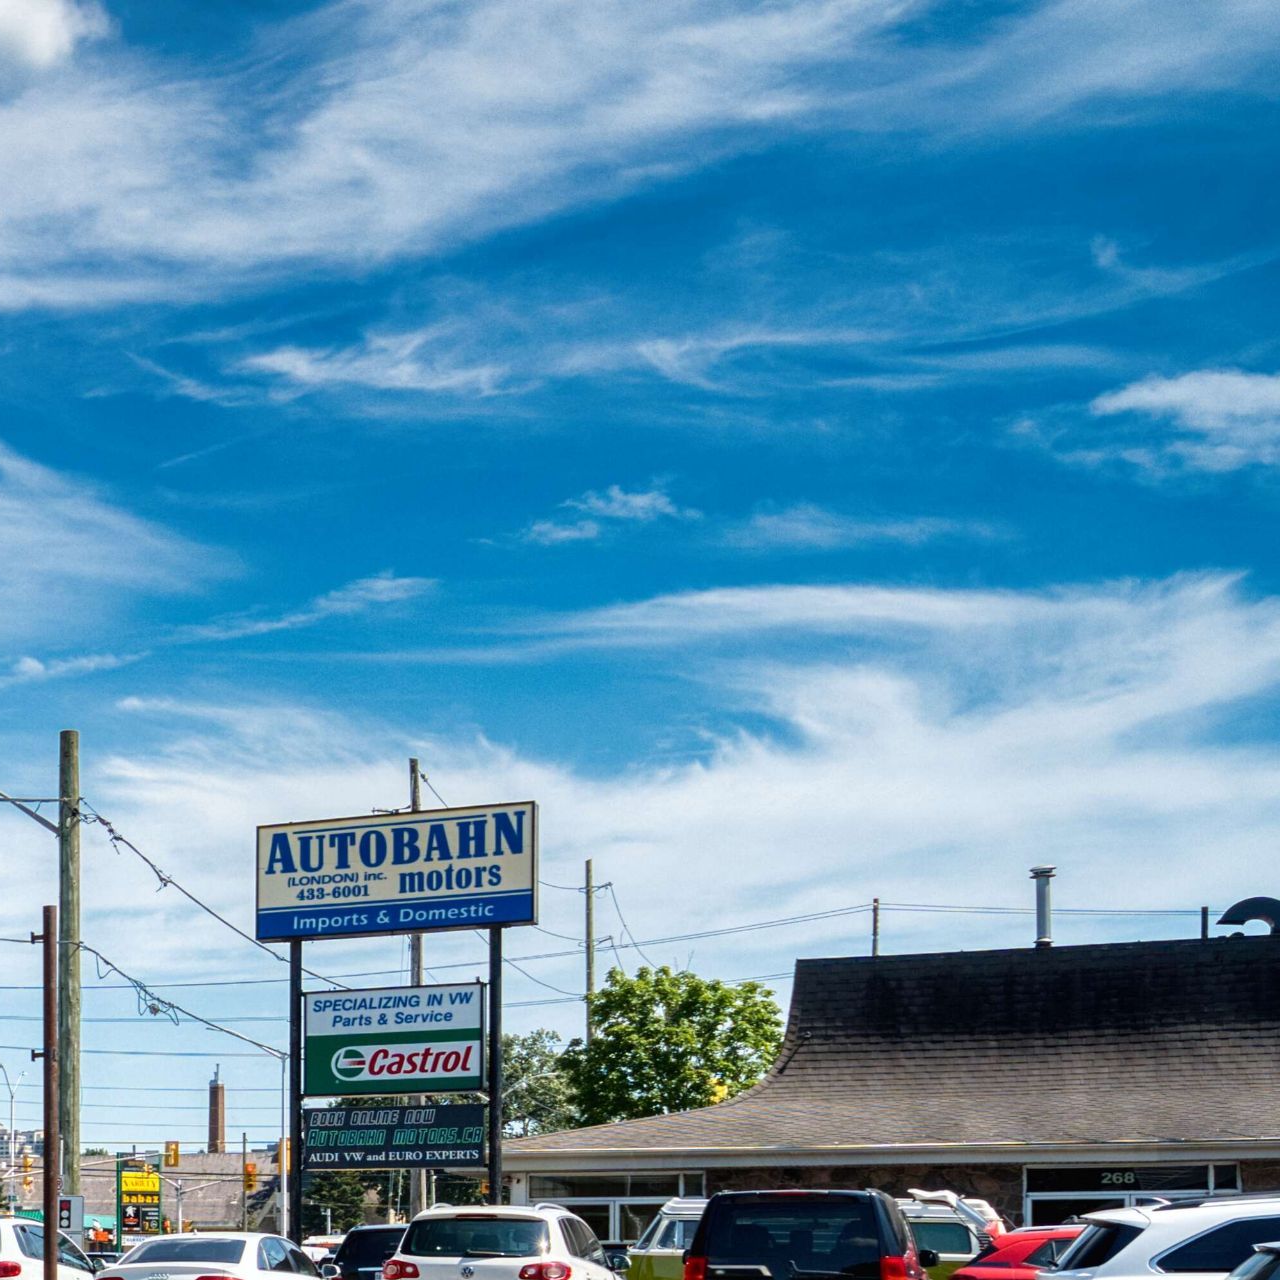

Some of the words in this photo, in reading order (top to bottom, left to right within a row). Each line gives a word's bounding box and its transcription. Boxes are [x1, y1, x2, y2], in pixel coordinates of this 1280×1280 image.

[265, 810, 526, 875] AUTOBAHN
[287, 873, 359, 888] (LONDON)
[364, 871, 387, 882] inc.
[399, 864, 502, 894] motors
[296, 885, 369, 901] 433-6001
[293, 911, 368, 932] Imports
[377, 910, 390, 923] &
[399, 903, 494, 923] Domestic
[313, 995, 420, 1012] SPECIALIZING
[427, 993, 443, 1006] IN
[449, 991, 474, 1005] VW
[332, 1014, 372, 1027] Parts
[377, 1013, 388, 1025] &
[394, 1010, 453, 1025] Service
[368, 1045, 473, 1076] Castrol
[310, 1111, 345, 1127] BOOK
[350, 1109, 399, 1125] ONLINE
[404, 1109, 436, 1124] NOW
[307, 1129, 386, 1147] AUTOBAHN
[309, 1152, 339, 1163] AUDI
[344, 1152, 365, 1162] VW
[366, 1152, 386, 1162] and
[388, 1150, 423, 1161] EURO
[425, 1150, 479, 1161] EXPERTS
[1101, 1171, 1135, 1184] 268
